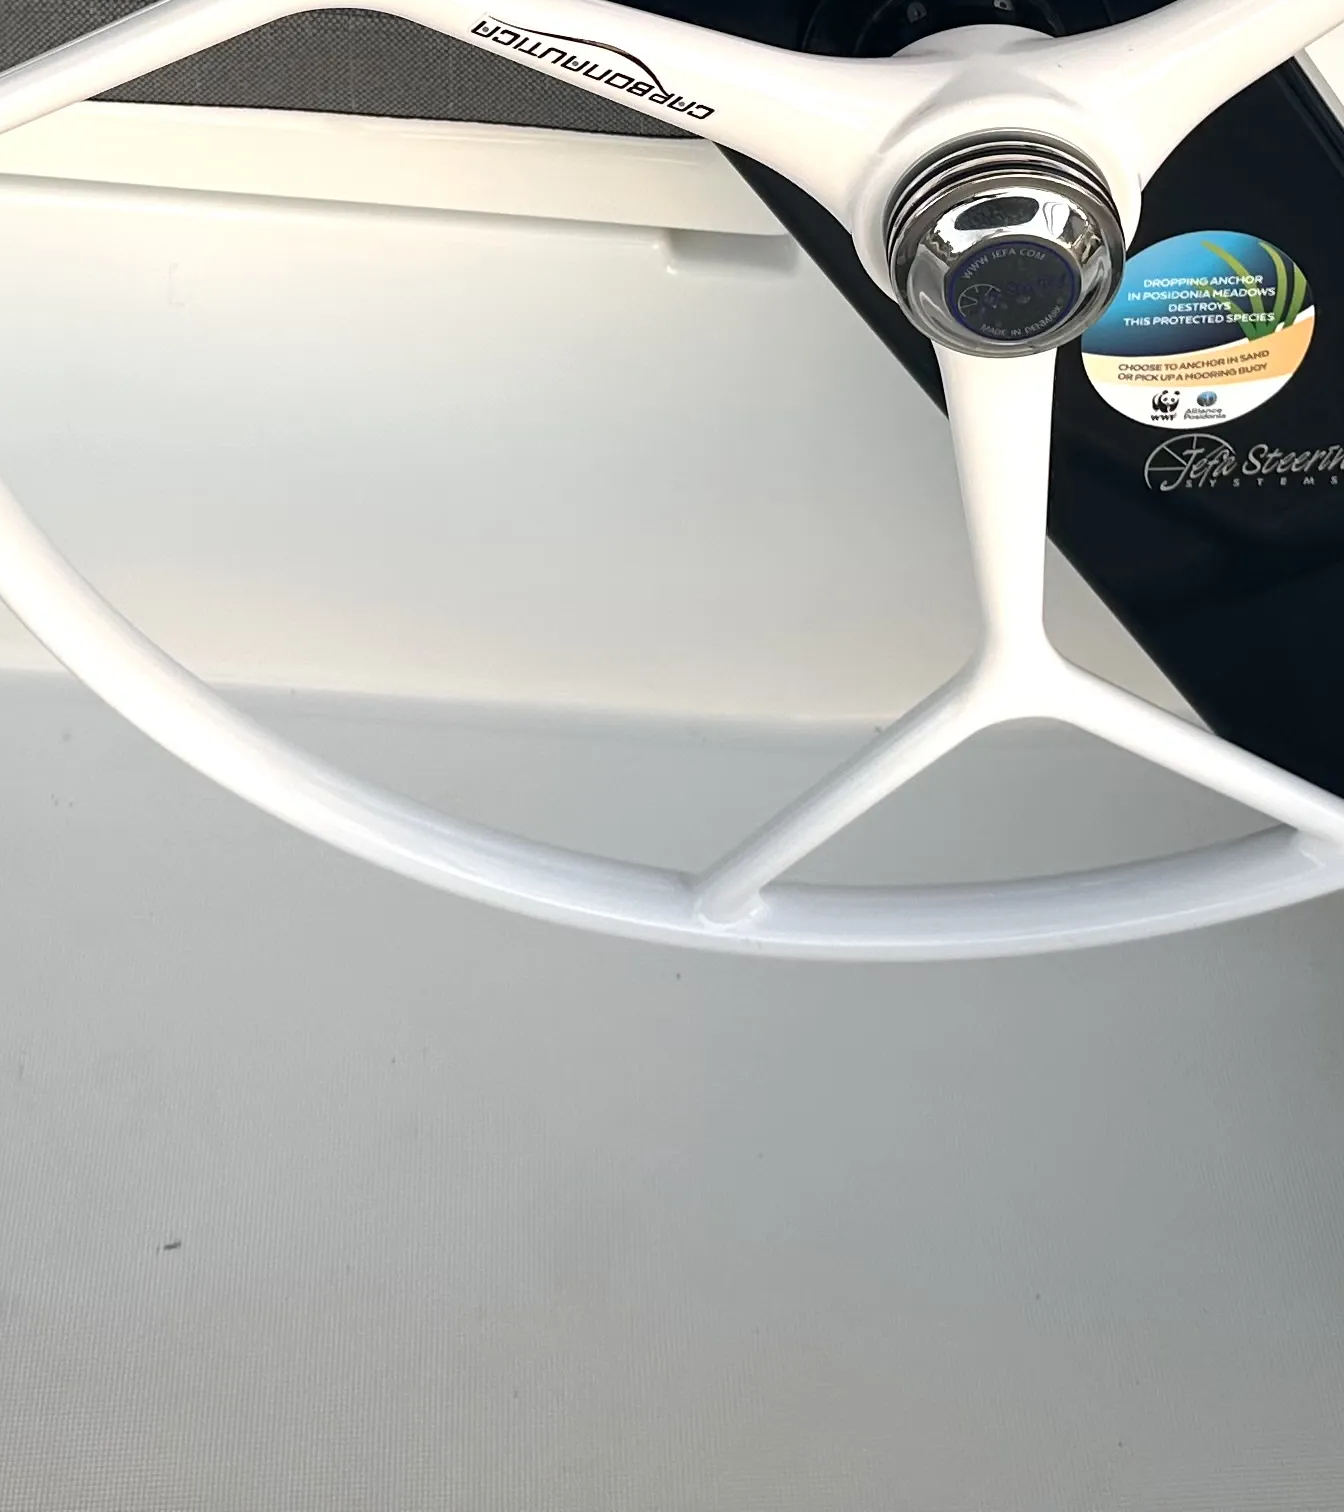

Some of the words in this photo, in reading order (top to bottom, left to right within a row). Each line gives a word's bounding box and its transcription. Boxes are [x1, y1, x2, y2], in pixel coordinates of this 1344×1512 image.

[471, 20, 715, 120] CARBONAUTICA
[1143, 278, 1209, 288] DROPPING
[1209, 274, 1264, 285] ANCHOR
[1127, 291, 1141, 301] IN
[1142, 288, 1211, 300] POSIDONIA
[1212, 287, 1276, 297] MEADOWS
[1168, 301, 1232, 312] DESTROYS
[1123, 316, 1151, 326] THIS
[1152, 314, 1224, 325] PROTECTED
[1226, 312, 1275, 322] SPECIES
[1118, 363, 1162, 371] CHOOSE
[1164, 363, 1178, 371] TO
[1179, 359, 1225, 370] ANCHOR
[1227, 357, 1239, 365] IN
[1240, 349, 1269, 362] SAND
[1117, 372, 1133, 381] OR
[1134, 373, 1158, 381] PICK
[1160, 373, 1176, 381] UP
[1184, 367, 1237, 380] MOORING
[1238, 362, 1267, 374] BUOY
